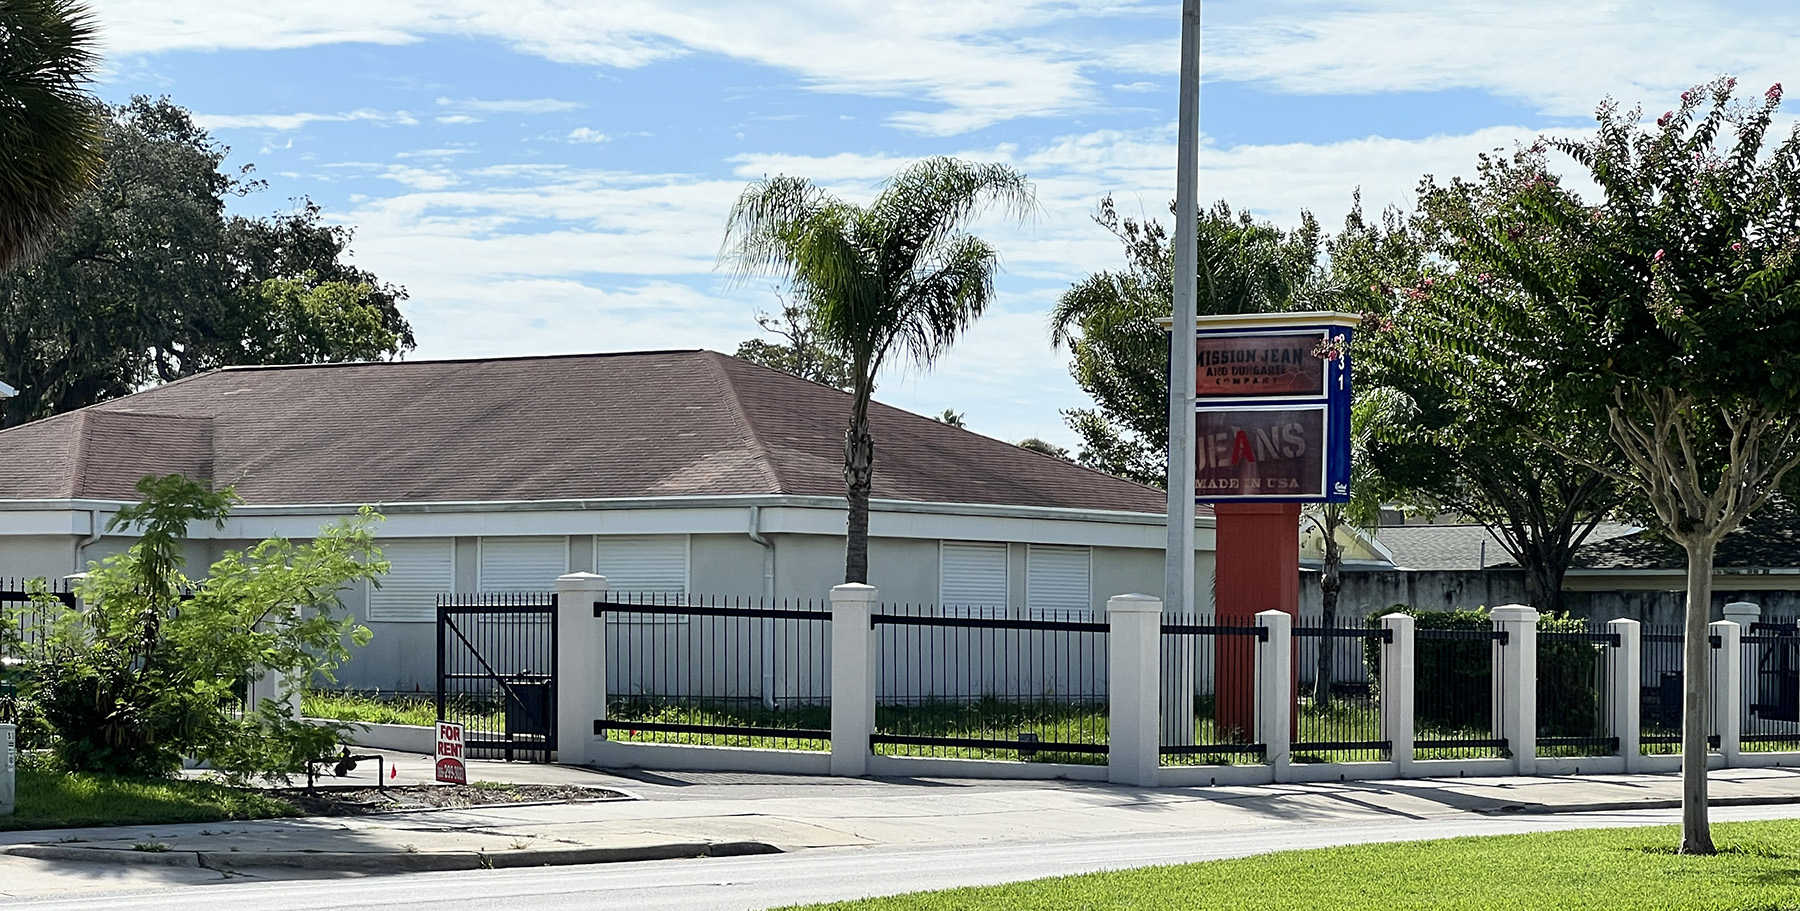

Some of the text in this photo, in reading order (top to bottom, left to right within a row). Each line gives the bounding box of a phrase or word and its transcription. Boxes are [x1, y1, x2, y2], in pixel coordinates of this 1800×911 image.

[1196, 348, 1303, 367] MISSION JEAN
[1206, 365, 1286, 376] AND DUNGAREE
[1196, 423, 1306, 471] JEANS
[1195, 477, 1300, 489] MADE IN USA
[440, 725, 461, 742] FOR
[438, 741, 463, 758] RENT
